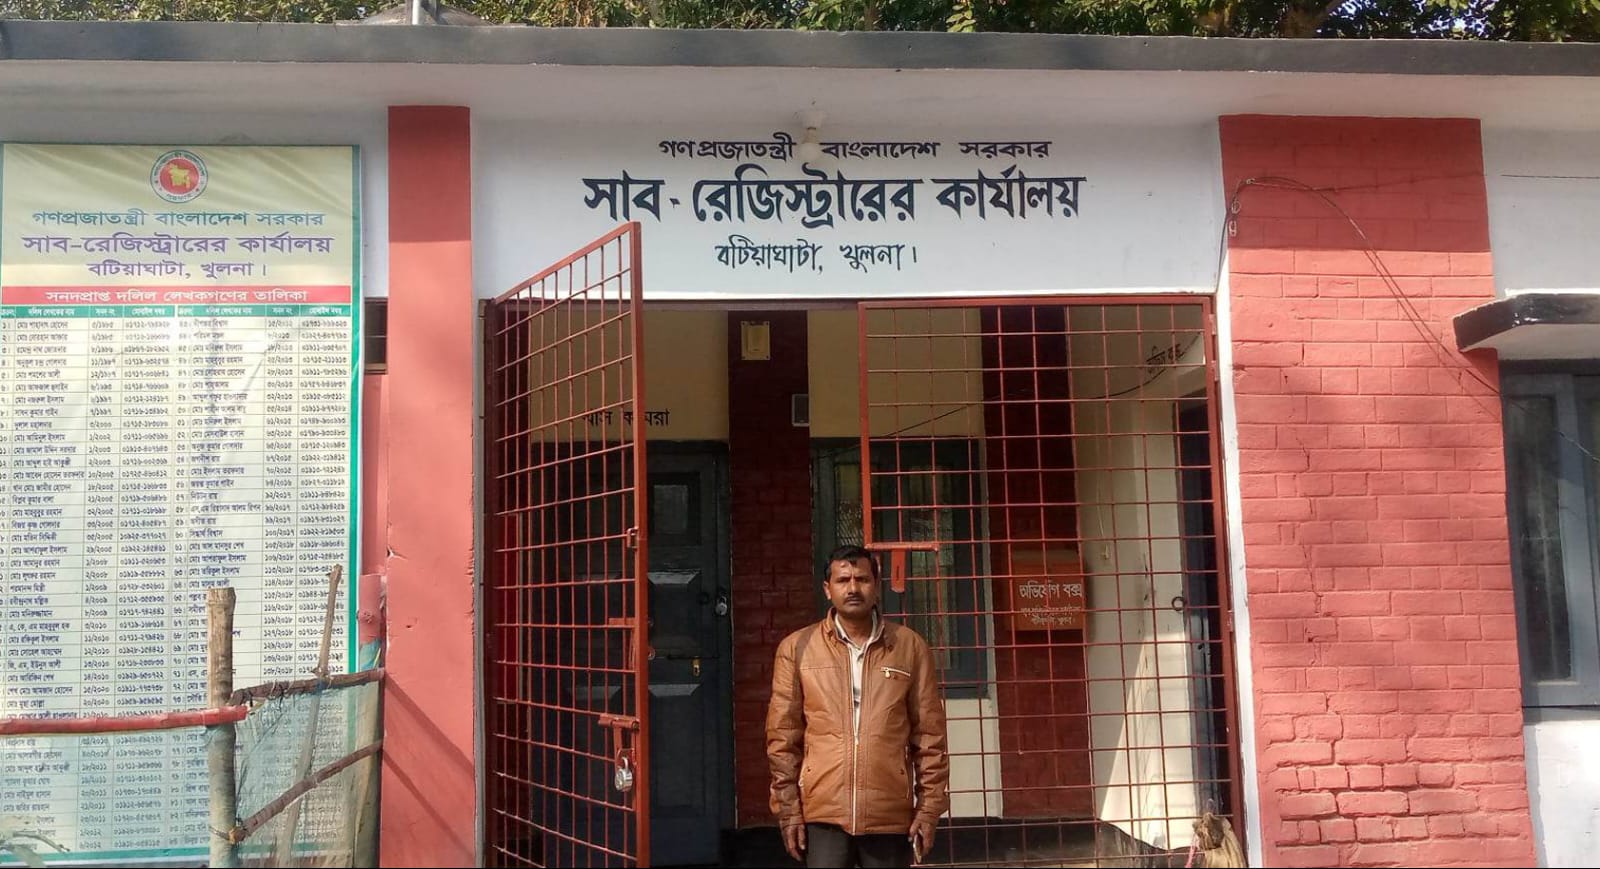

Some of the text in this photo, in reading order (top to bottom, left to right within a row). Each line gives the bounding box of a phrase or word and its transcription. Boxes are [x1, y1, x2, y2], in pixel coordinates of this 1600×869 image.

[659, 132, 1051, 162] গণপ্রজাতন্ত্রী বাংলাদেশ সরকার
[931, 164, 1086, 218] কার্যালয়
[32, 208, 326, 227] গণপ্রজাতন্ত্রী বাংলাদেশ সরকার
[23, 231, 335, 256] সাব-রেজিস্ট্রারের কার্যালয়
[716, 234, 823, 273] বটিয়াঘাটা,
[88, 259, 190, 279] বটিয়াঘাটা,
[46, 290, 308, 303] সনদপ্রাপ্ত দলিল লেখকগণের তালিকা
